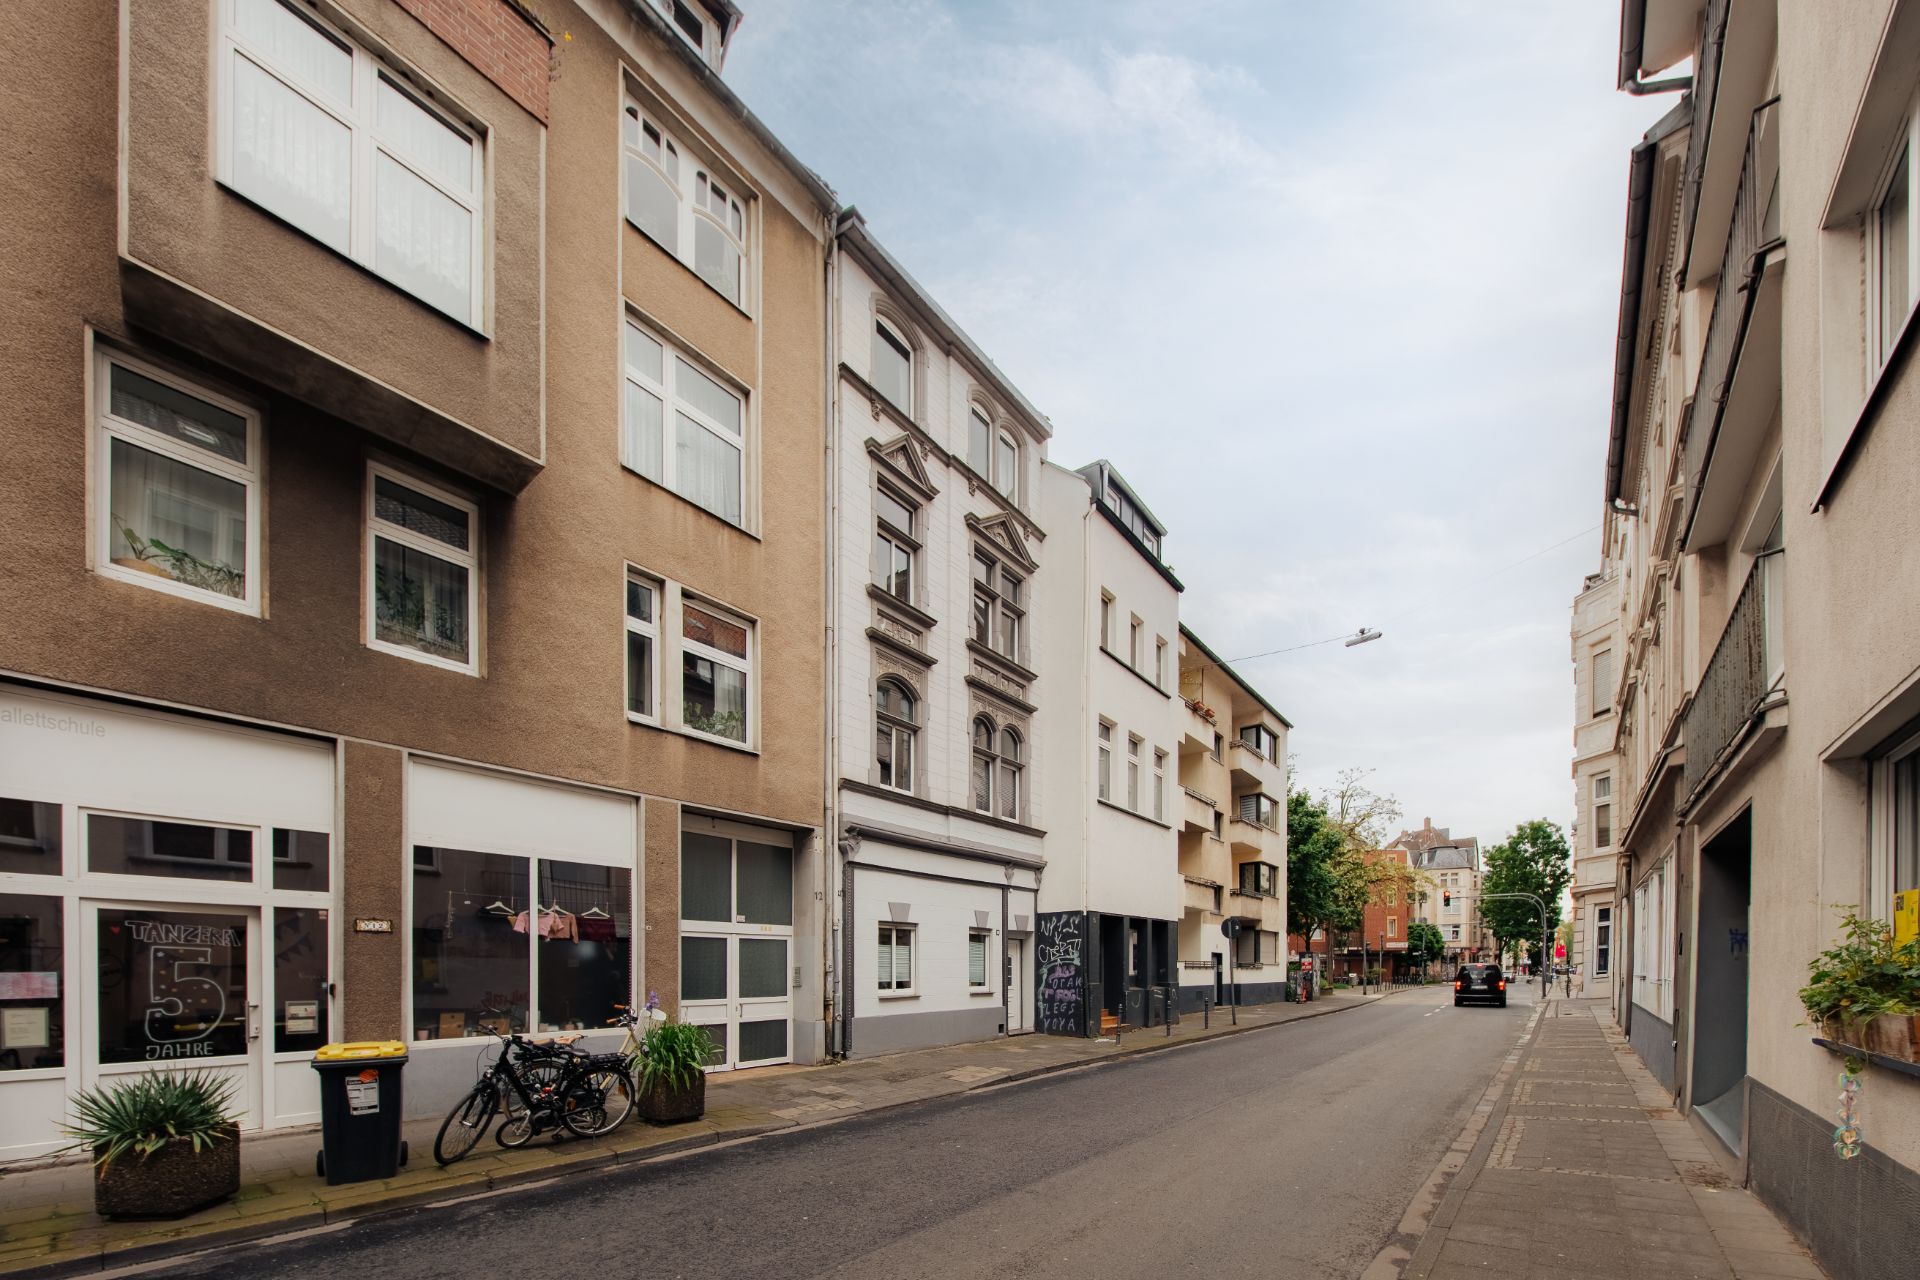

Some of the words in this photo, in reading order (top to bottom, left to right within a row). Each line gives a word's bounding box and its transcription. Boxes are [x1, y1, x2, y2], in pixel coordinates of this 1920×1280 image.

[0, 708, 105, 737] allettschule
[814, 891, 823, 901] 12
[145, 946, 225, 1043] 5
[146, 1042, 215, 1060] JAHRE
